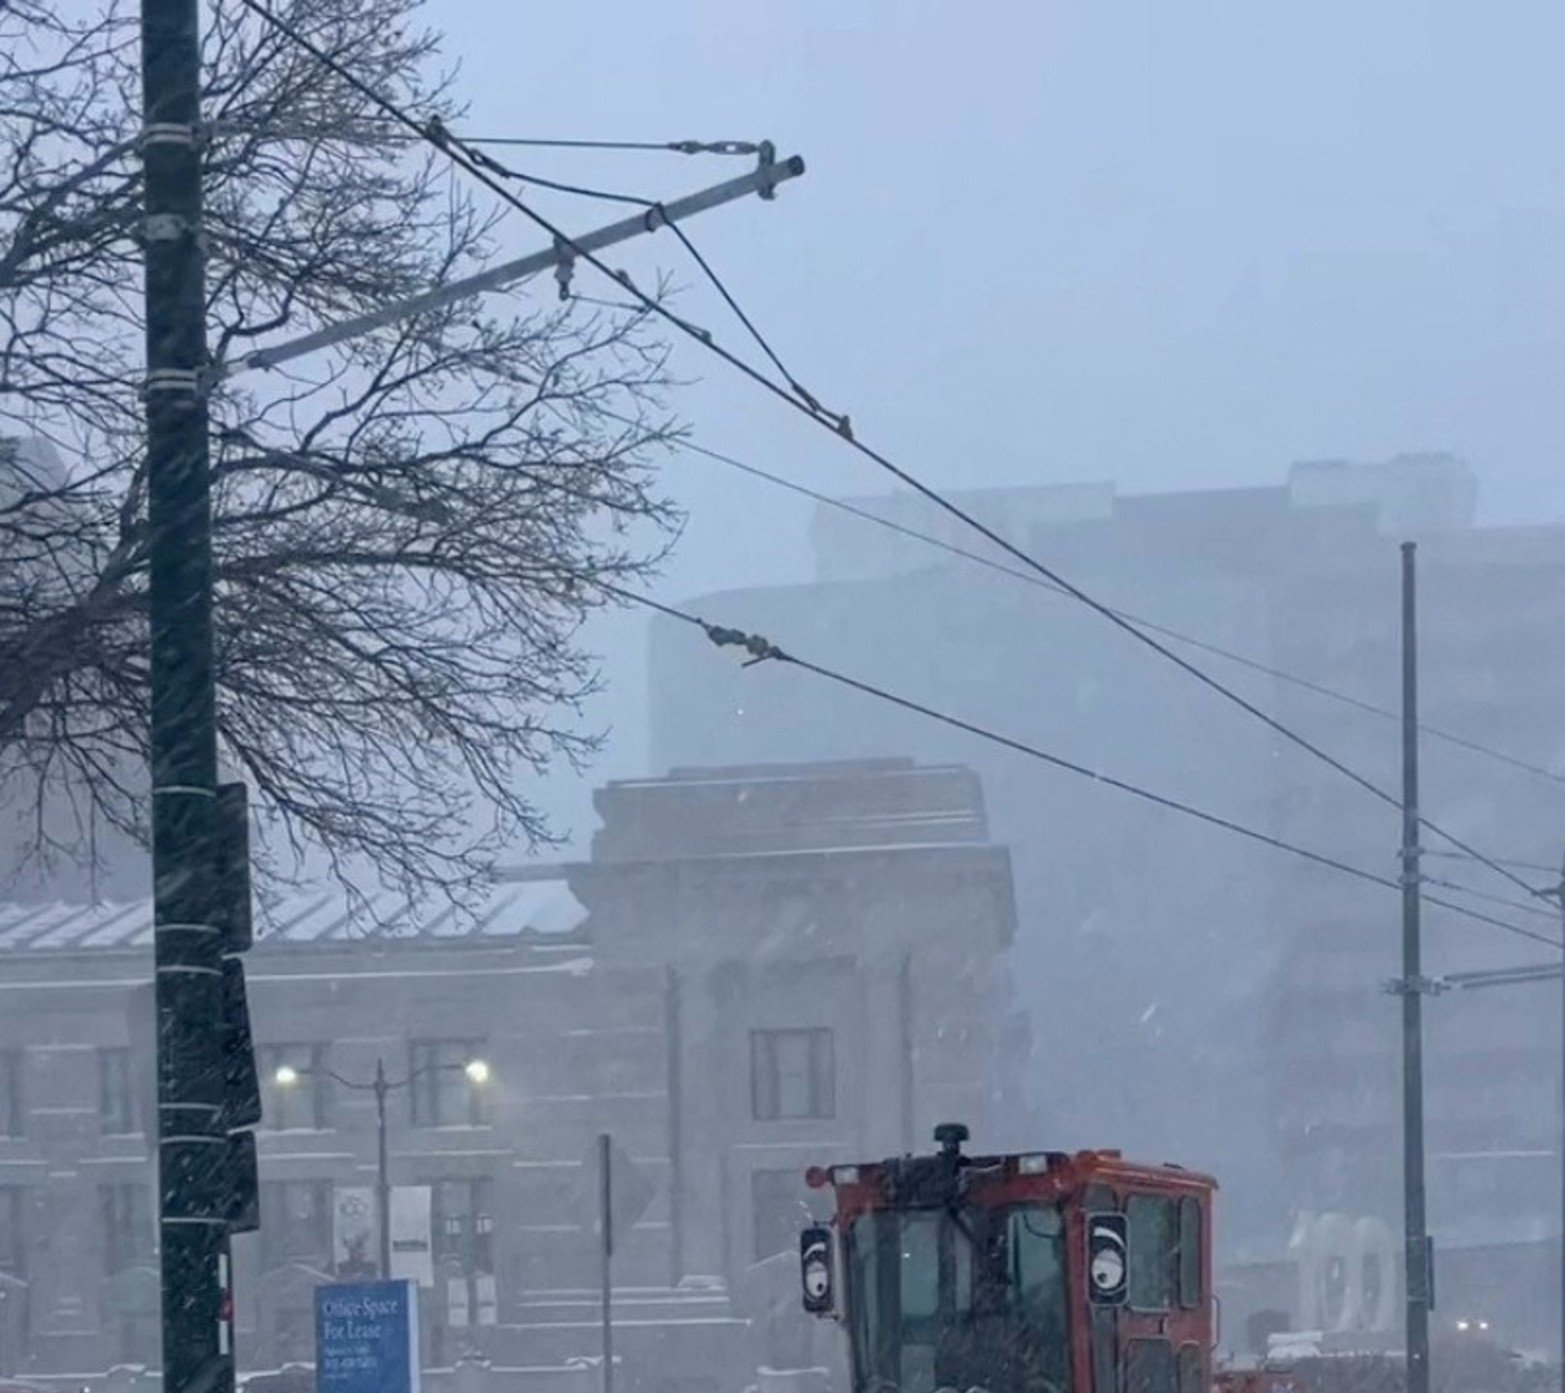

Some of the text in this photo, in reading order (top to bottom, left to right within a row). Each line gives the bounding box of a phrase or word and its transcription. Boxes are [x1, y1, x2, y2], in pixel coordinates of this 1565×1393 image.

[322, 1297, 398, 1320] Office Space
[324, 1321, 381, 1339] For Lease
